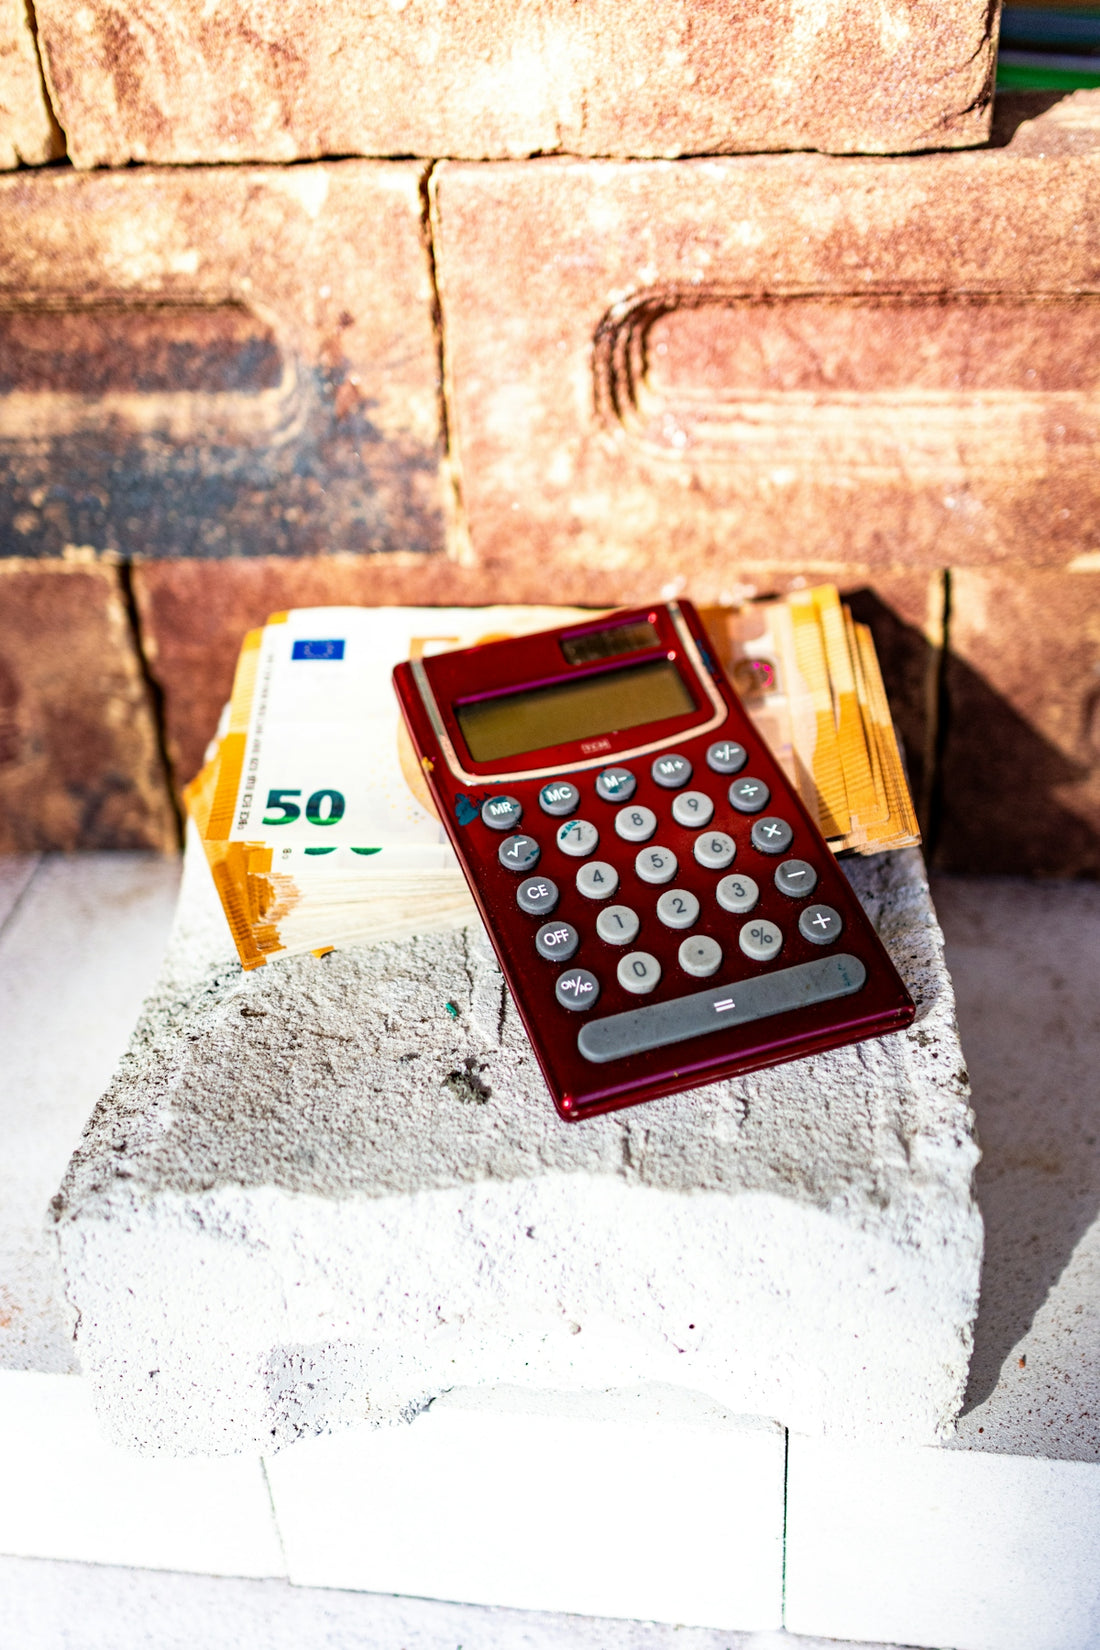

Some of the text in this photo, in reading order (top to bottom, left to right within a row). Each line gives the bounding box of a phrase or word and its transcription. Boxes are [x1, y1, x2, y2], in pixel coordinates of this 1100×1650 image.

[660, 760, 684, 774] M+
[546, 786, 572, 803] MC
[262, 789, 346, 826] 50
[490, 800, 513, 816] MR
[687, 798, 699, 812] 9
[631, 812, 644, 826] 8
[572, 827, 583, 841] 7
[711, 838, 723, 853] 6
[650, 854, 664, 869] 5
[593, 869, 605, 883] 4
[527, 884, 549, 899] CE
[732, 882, 746, 897] 3
[672, 898, 687, 913] 2
[612, 914, 624, 929] 1
[543, 928, 570, 946] OFF
[751, 926, 773, 945] %
[632, 961, 647, 977] 0
[560, 976, 593, 997] ON/AC
